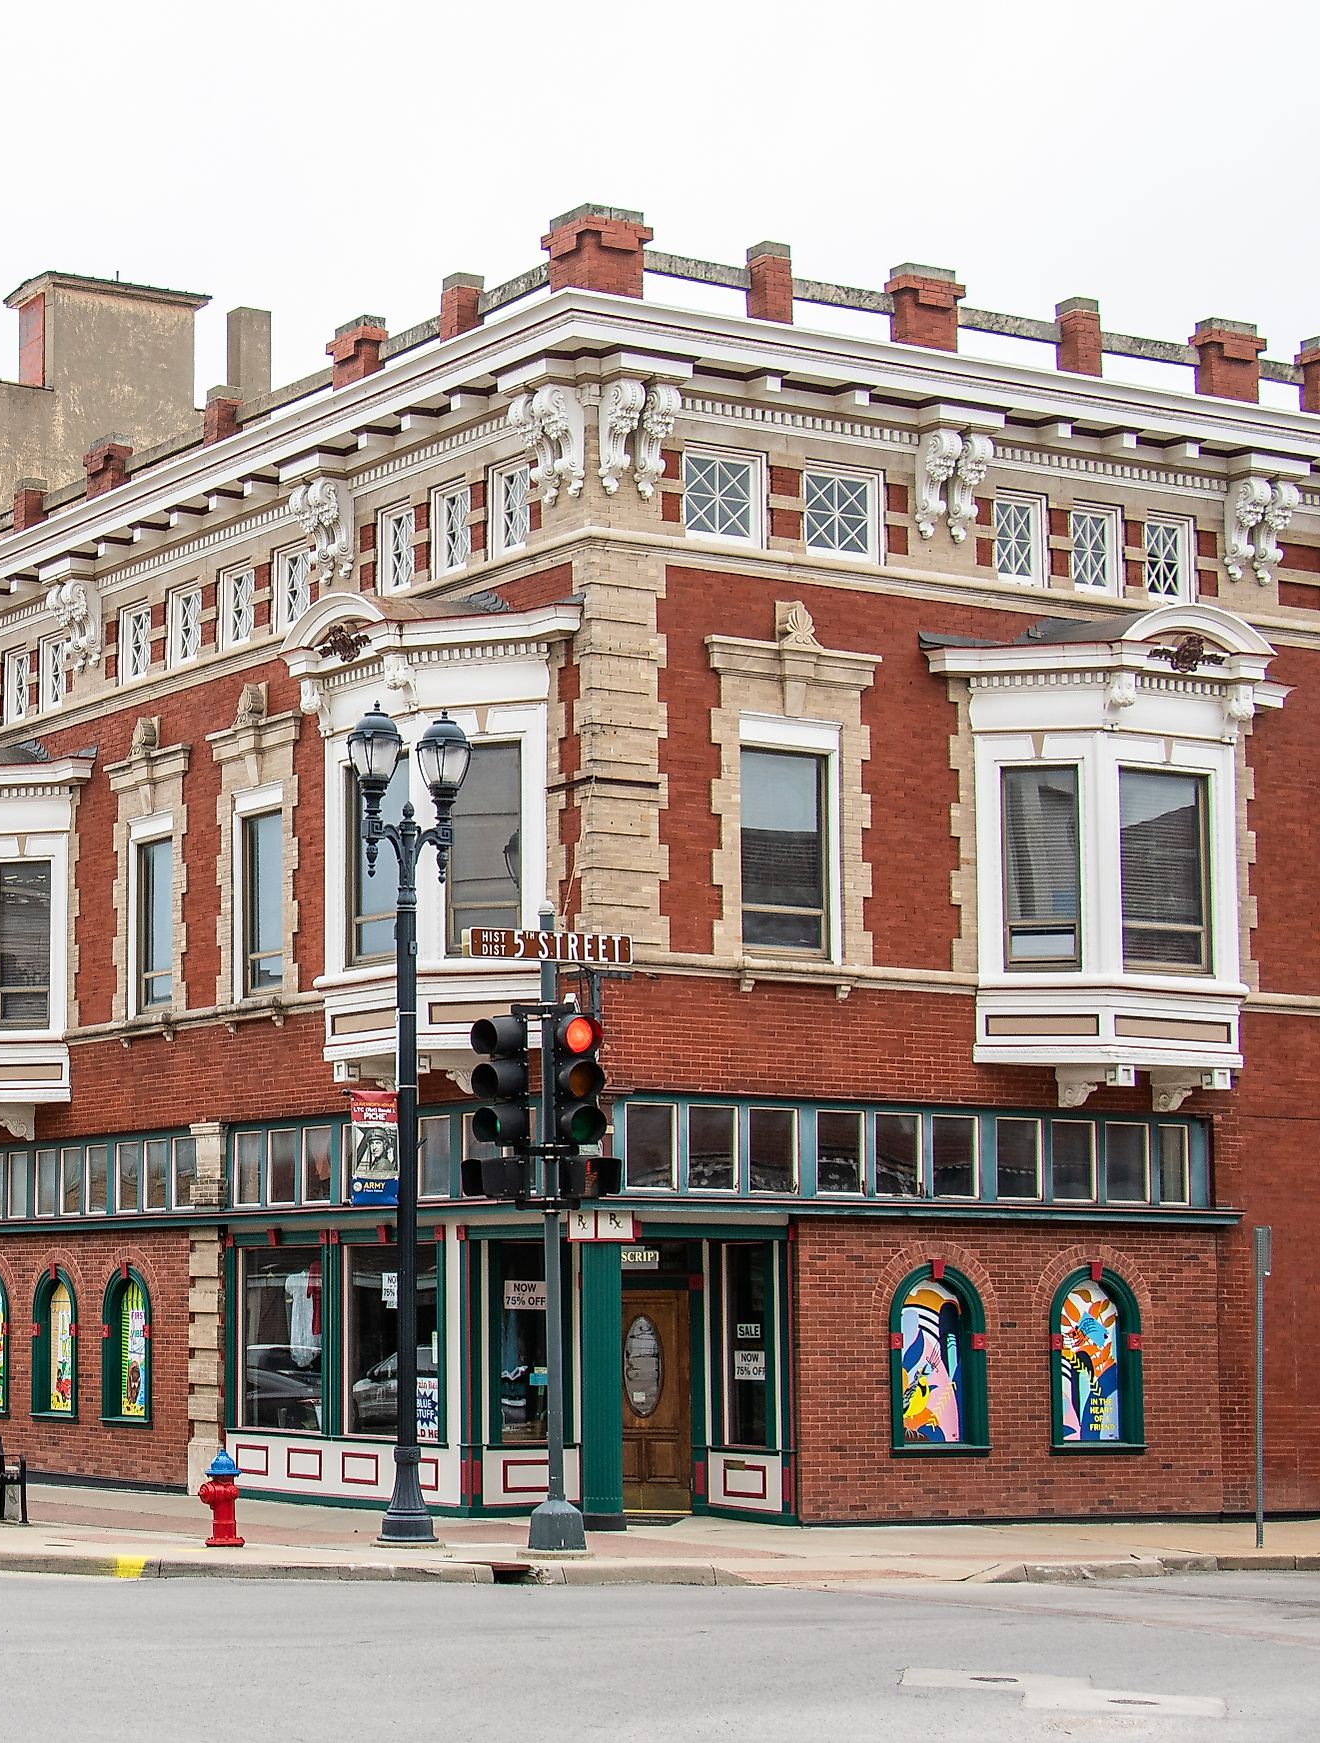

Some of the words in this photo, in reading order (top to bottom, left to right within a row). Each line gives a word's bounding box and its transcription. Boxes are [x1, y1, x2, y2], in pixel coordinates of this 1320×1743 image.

[482, 931, 506, 943] HIST
[482, 944, 506, 956] DIST
[513, 930, 535, 958] 5TH
[538, 931, 622, 963] STREET
[363, 1181, 386, 1190] ARMY
[387, 1276, 397, 1284] NO
[383, 1288, 395, 1297] 75%
[513, 1283, 537, 1293] NOW
[505, 1296, 526, 1306] 75%
[528, 1296, 547, 1306] OFF
[738, 1325, 760, 1336] SALE
[740, 1353, 759, 1362] NOW
[736, 1366, 751, 1375] 75%
[417, 1380, 428, 1389] ain
[416, 1399, 432, 1409] BLUE
[416, 1409, 435, 1420] STUFF
[1090, 1423, 1115, 1431] FRIEND
